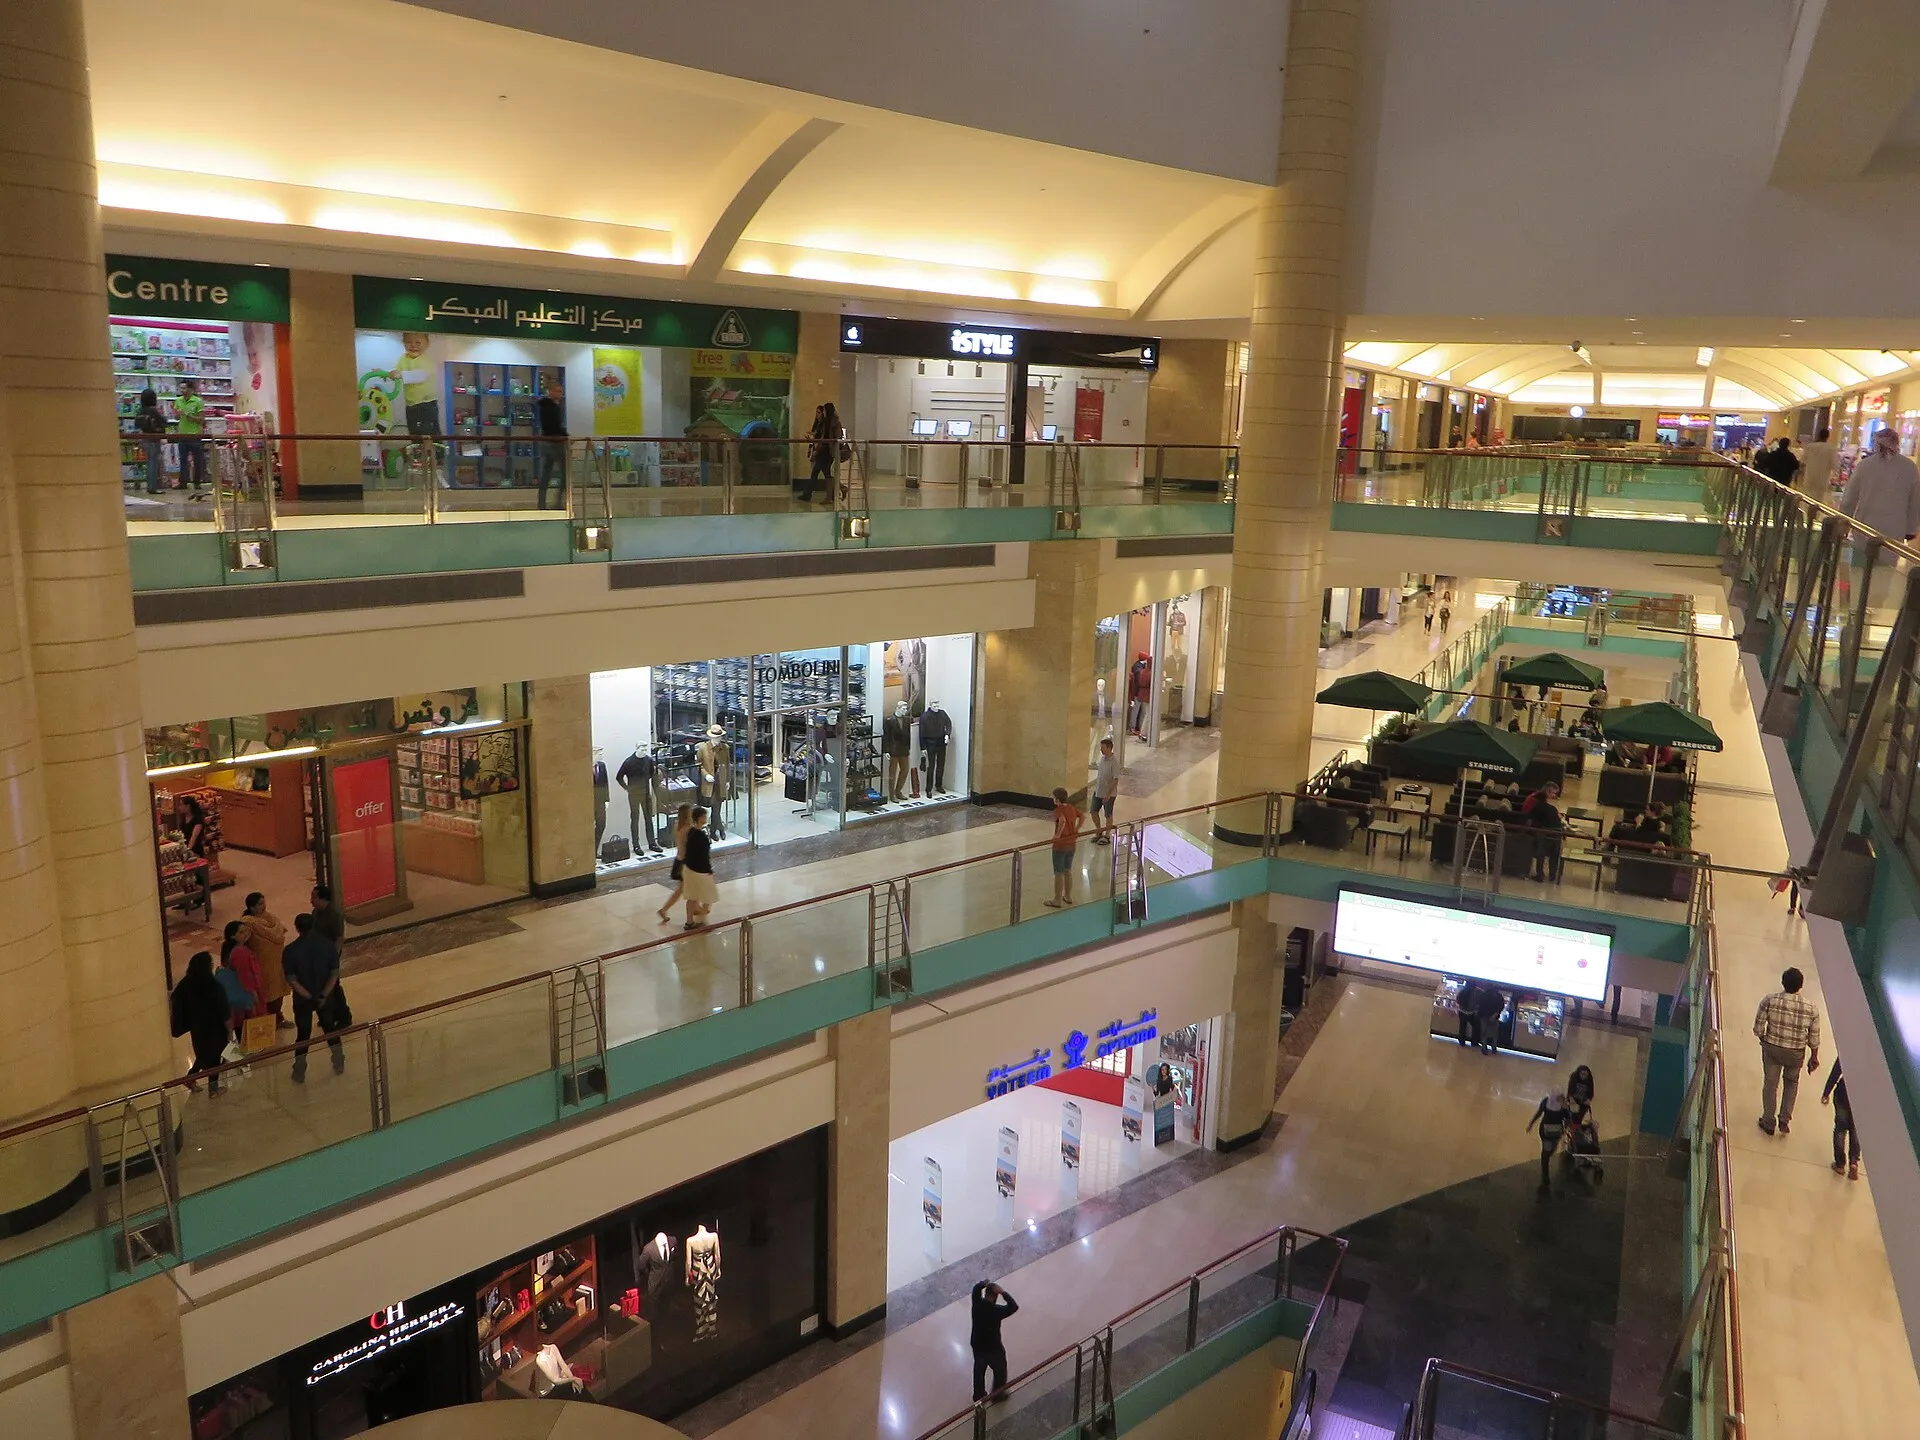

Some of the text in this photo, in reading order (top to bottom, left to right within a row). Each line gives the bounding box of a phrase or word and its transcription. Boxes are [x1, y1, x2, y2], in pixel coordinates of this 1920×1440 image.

[107, 270, 229, 305] Centre
[425, 297, 644, 334] مركز التعليم المبكر
[697, 350, 723, 365] free
[755, 660, 840, 684] TOMBOLINI
[1553, 682, 1590, 692] STARBUCKS
[1671, 740, 1717, 752] STARBUCKS
[1468, 761, 1514, 773] STARBUCKS
[355, 801, 385, 818] offer
[370, 1300, 406, 1330] CH
[312, 1302, 458, 1372] CAROLINA HERRERA
